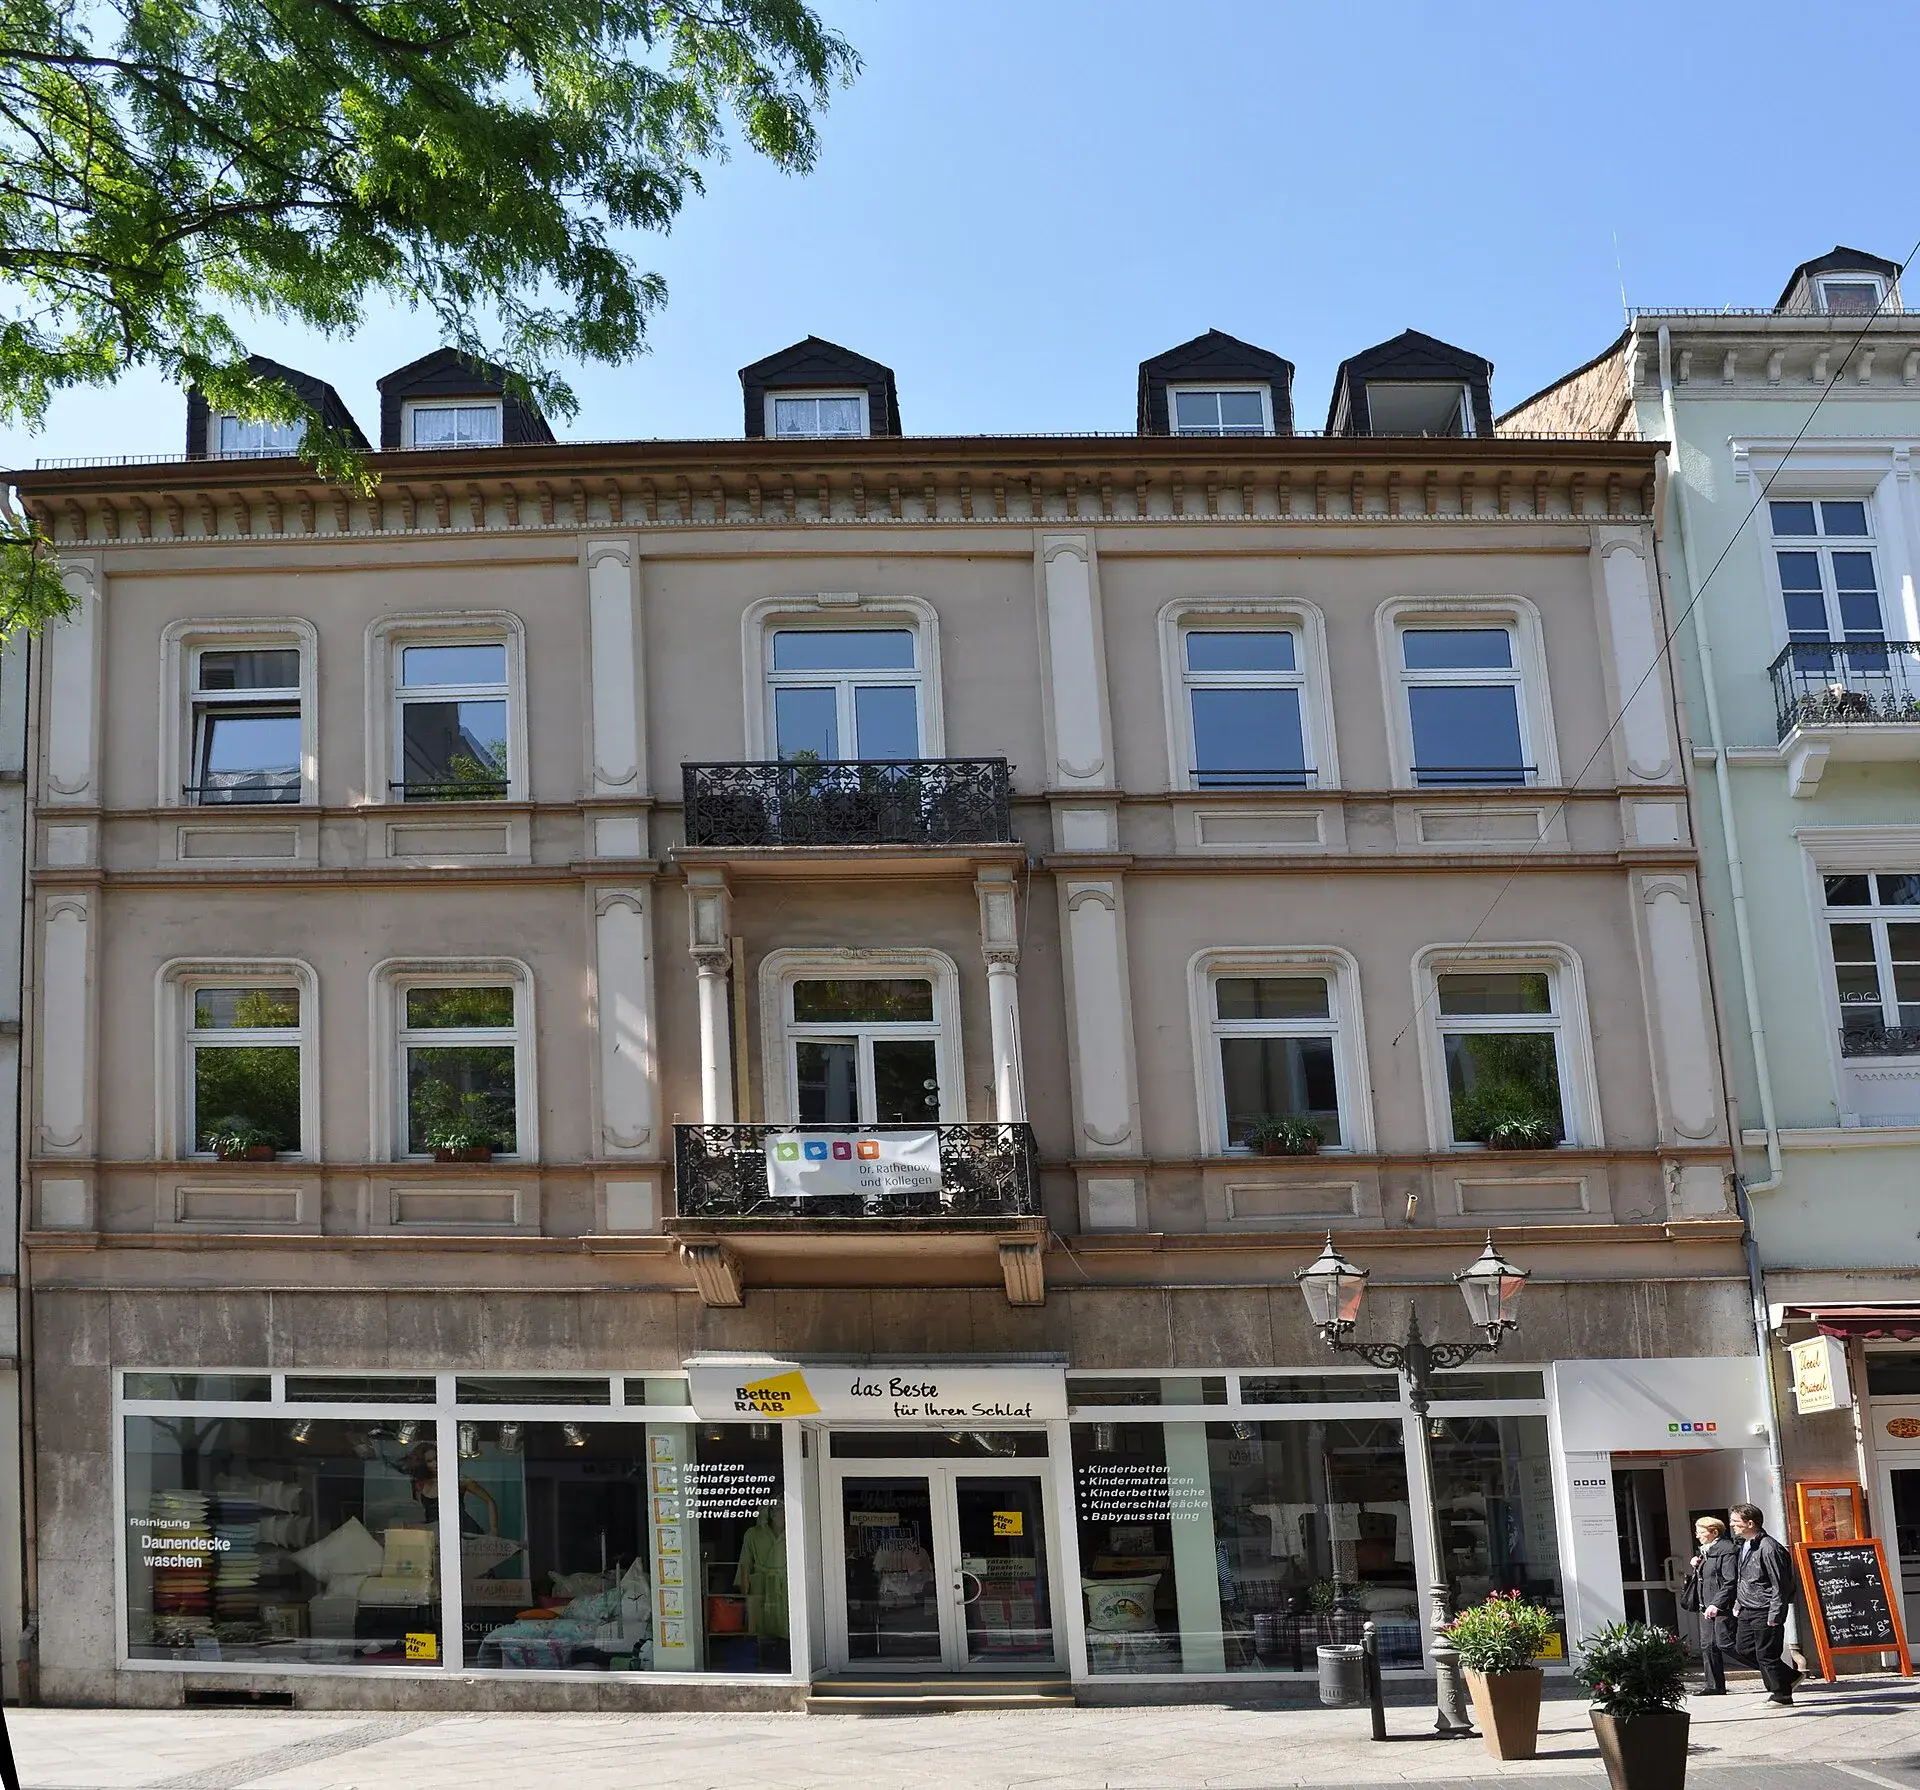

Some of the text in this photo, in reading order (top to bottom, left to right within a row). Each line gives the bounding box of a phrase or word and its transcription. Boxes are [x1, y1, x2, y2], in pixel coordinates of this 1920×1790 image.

[859, 1162, 931, 1174] Dr. Rathenow
[860, 1176, 932, 1187] und Kollegen
[850, 1376, 939, 1398] das Beste
[735, 1387, 791, 1401] Betten
[734, 1401, 785, 1412] RAAB
[893, 1402, 1033, 1418] für Ihren Schlaf
[683, 1463, 745, 1472] Matratzen
[1087, 1465, 1171, 1474] Kinderbetten
[683, 1474, 776, 1485] Schlafsysteme
[1088, 1476, 1194, 1486] Kindermatratzen
[684, 1486, 771, 1495] Wasserbetten
[1089, 1488, 1206, 1498] Kinderbettwäsche
[685, 1498, 778, 1507] Daunendecken
[1090, 1499, 1209, 1509] Kinderschlafsäcke
[686, 1509, 760, 1519] Bettwäsche
[1091, 1512, 1200, 1522] Babyausstattung
[129, 1517, 191, 1529] Reinigung
[993, 1514, 1013, 1525] etten
[994, 1521, 1007, 1530] AB
[141, 1535, 231, 1551] Daunendecke
[143, 1554, 203, 1568] waschen
[464, 1622, 503, 1632] SCHLO
[406, 1636, 427, 1648] etten
[407, 1644, 420, 1653] AB
